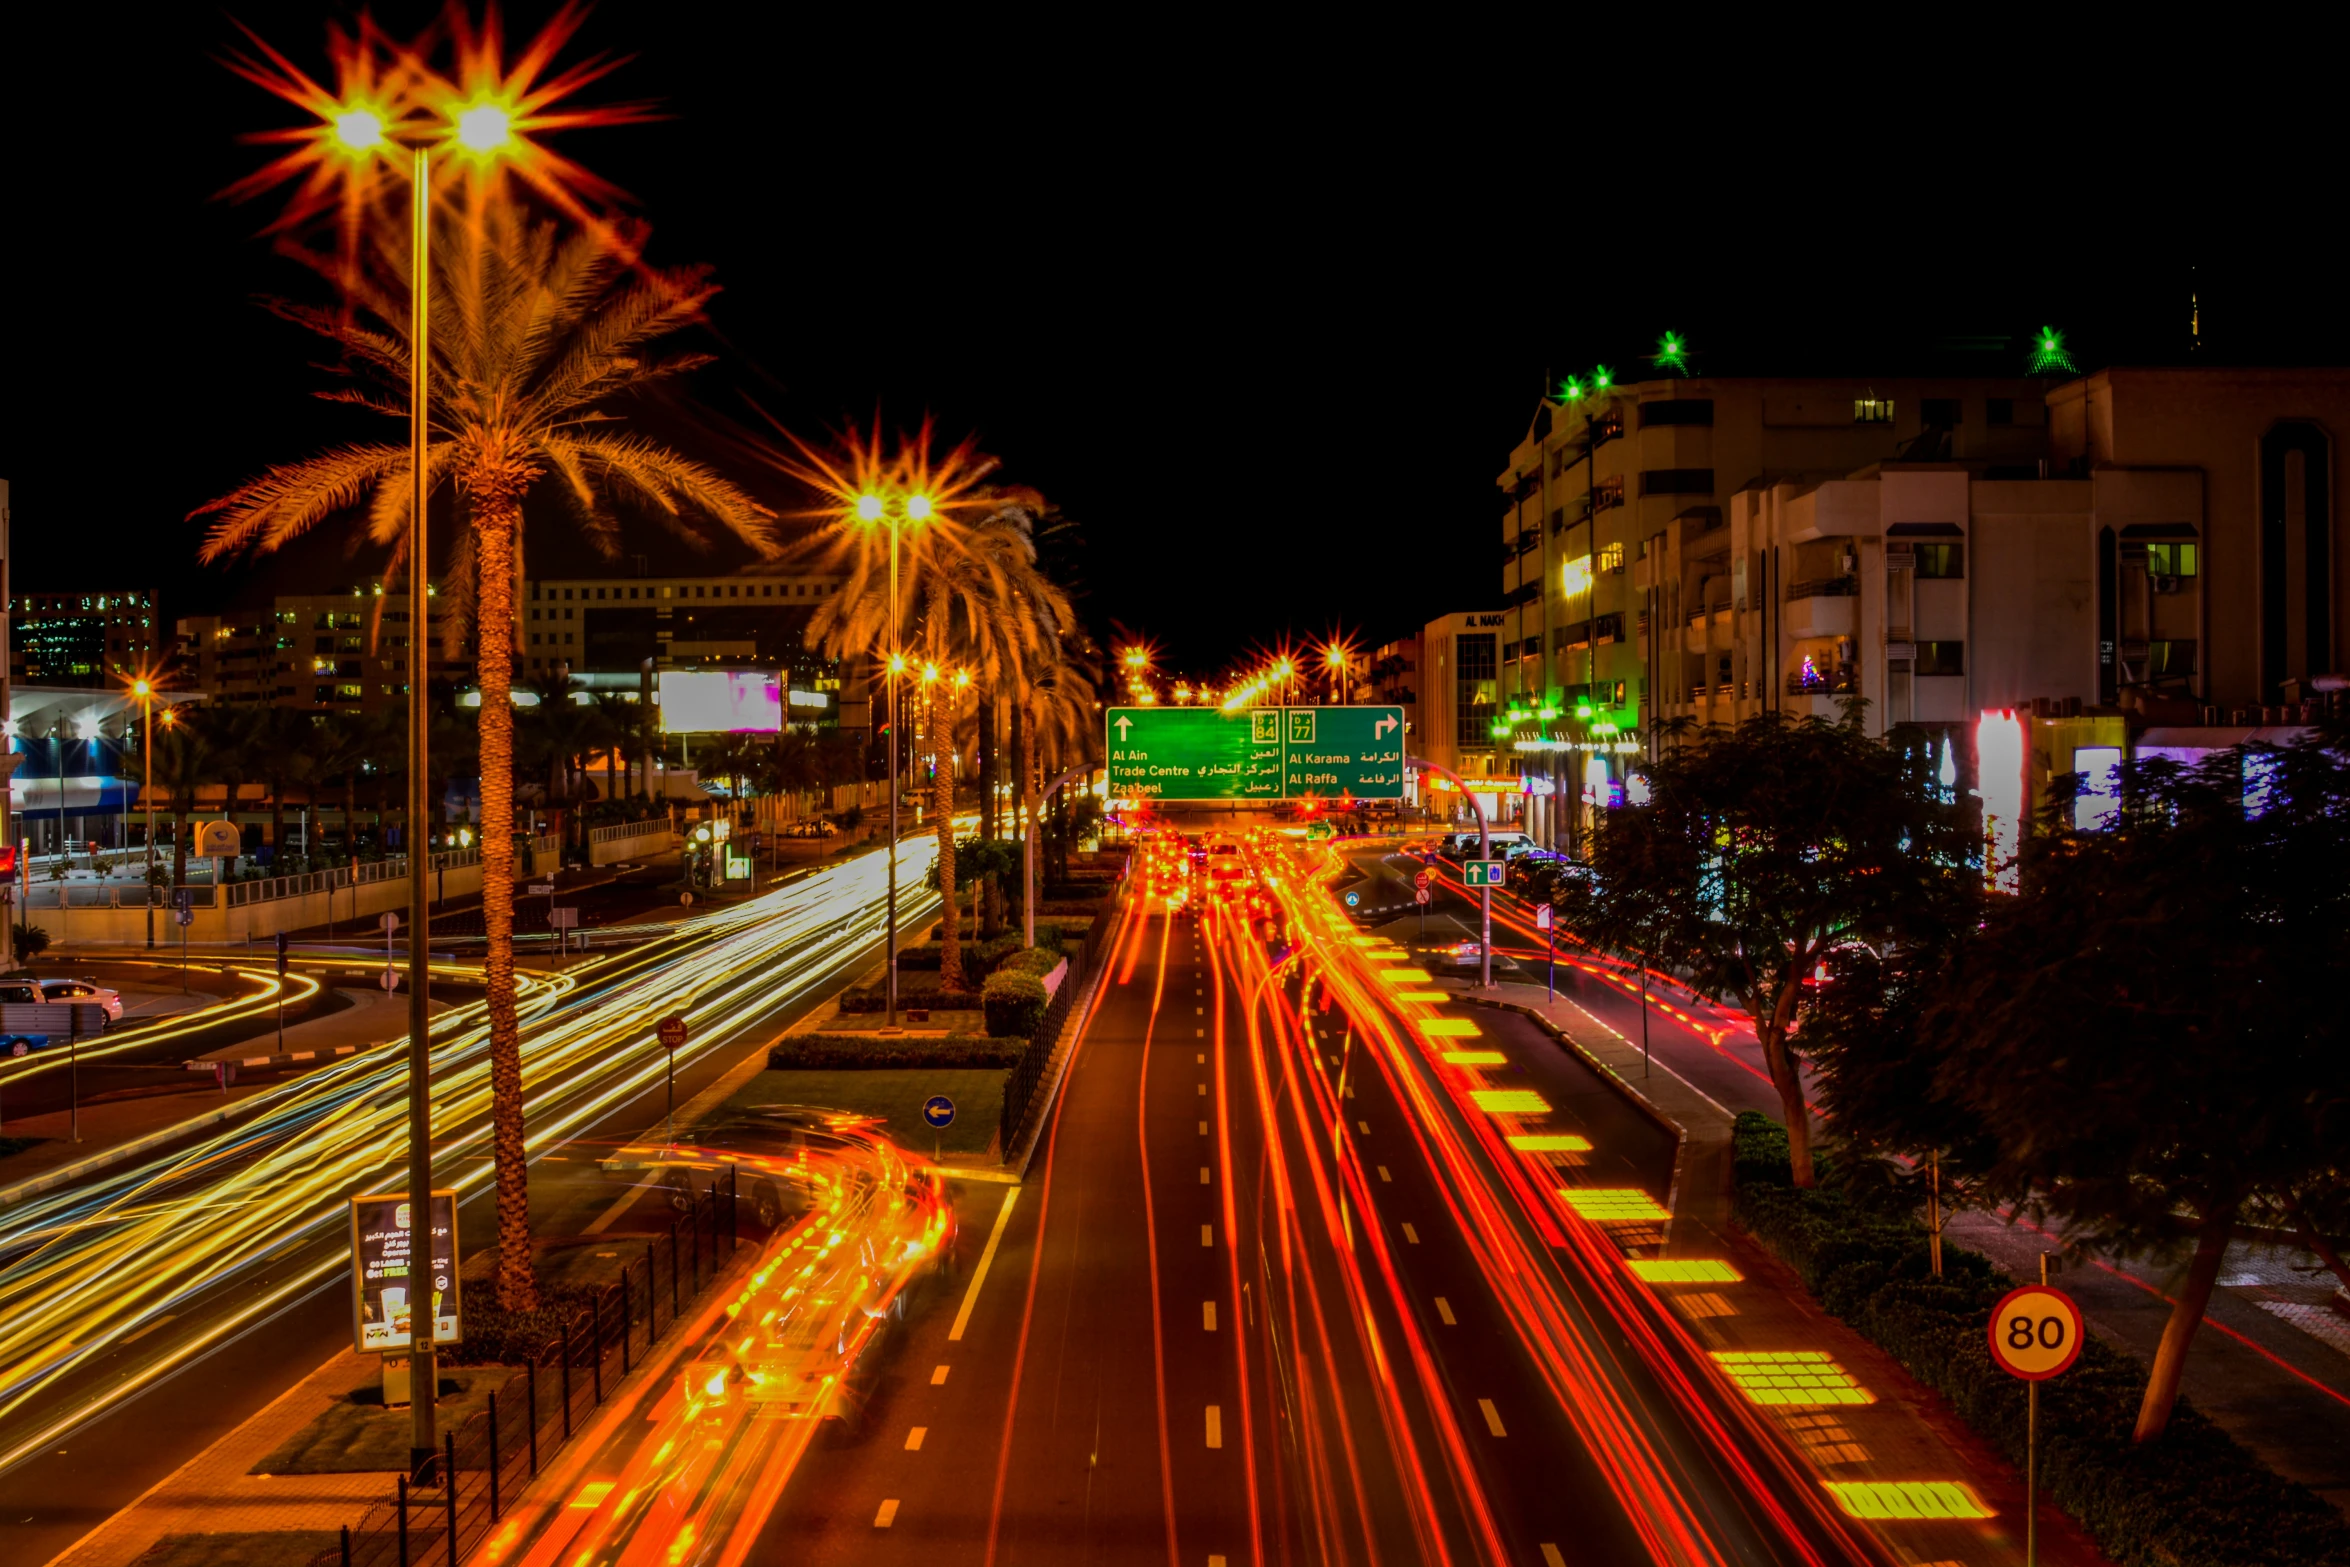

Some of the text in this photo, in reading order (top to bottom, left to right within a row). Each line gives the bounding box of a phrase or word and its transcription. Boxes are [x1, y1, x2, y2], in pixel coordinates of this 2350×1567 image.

[1465, 616, 1477, 627] AL
[1268, 717, 1274, 725] د
[1305, 717, 1311, 725] د
[1255, 726, 1275, 739] 84
[1294, 726, 1311, 739] 77
[1112, 750, 1148, 761] Al Ain
[1250, 748, 1279, 760] العين
[1289, 753, 1350, 764] Al Karama
[1360, 752, 1399, 764] الكرامة
[1112, 765, 1190, 777] Trade Centre
[1197, 764, 1279, 778] المركز التجاري
[1289, 773, 1338, 784] Al Raffa
[1359, 774, 1400, 786] الرفاعة
[1112, 782, 1162, 793] Zaa'beel
[1245, 781, 1279, 793] زعبيل
[662, 1021, 683, 1033] قف
[662, 1035, 683, 1044] STOP
[366, 1269, 383, 1279] Get
[383, 1266, 409, 1278] FREE
[2007, 1315, 2065, 1350] 80
[420, 1341, 429, 1350] 12
